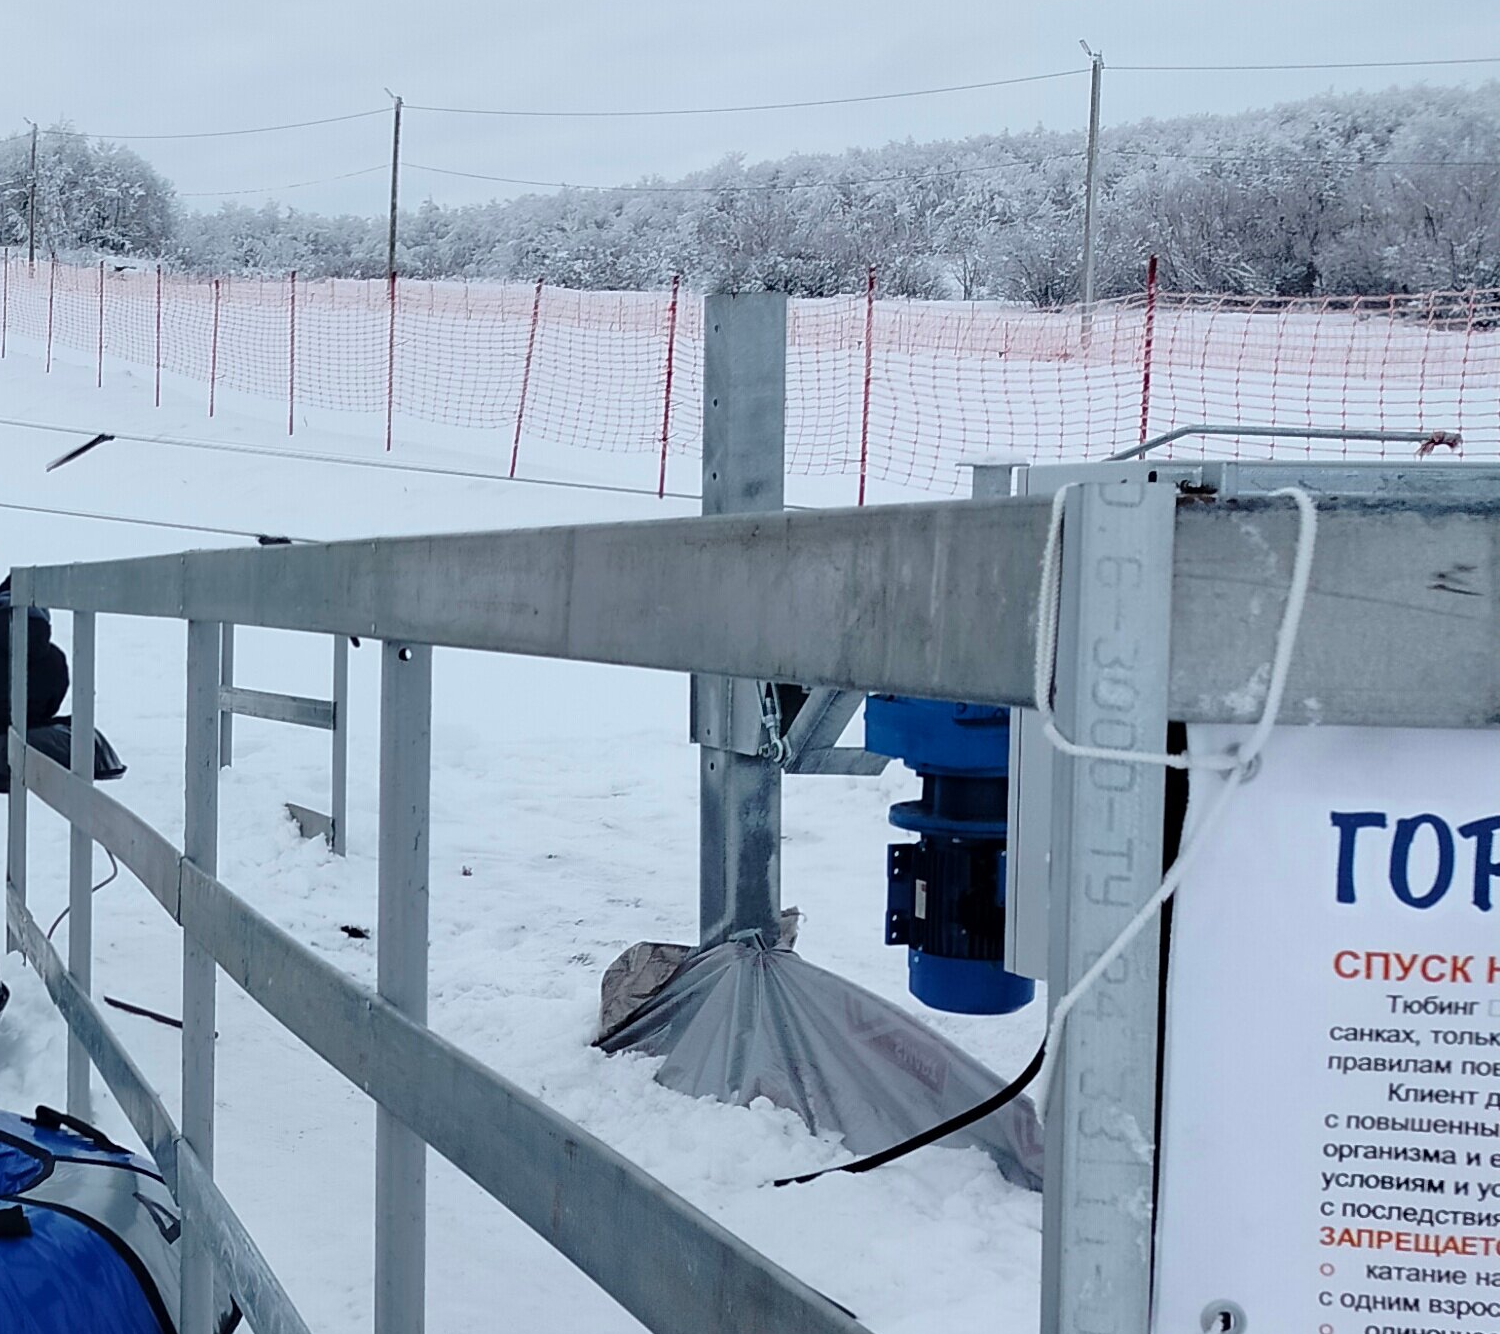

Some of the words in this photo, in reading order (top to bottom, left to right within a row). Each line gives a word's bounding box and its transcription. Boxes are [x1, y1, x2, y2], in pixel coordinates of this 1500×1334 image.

[1333, 950, 1475, 983] СПУСК
[1387, 994, 1480, 1016] Тюбинг
[1329, 1025, 1421, 1046] санках,
[1327, 1055, 1452, 1074] правилам
[1388, 1083, 1480, 1106] Клиент
[1324, 1114, 1339, 1129] с
[1323, 1143, 1456, 1165] организма
[1466, 1151, 1481, 1166] и
[1320, 1171, 1445, 1194] условиям
[1454, 1181, 1469, 1196] и
[1320, 1201, 1334, 1216] с
[1319, 1226, 1500, 1256] ЗАПРЕЩАЕТ
[1366, 1264, 1467, 1285] катание
[1318, 1291, 1332, 1306] с
[1340, 1292, 1420, 1313] одним
